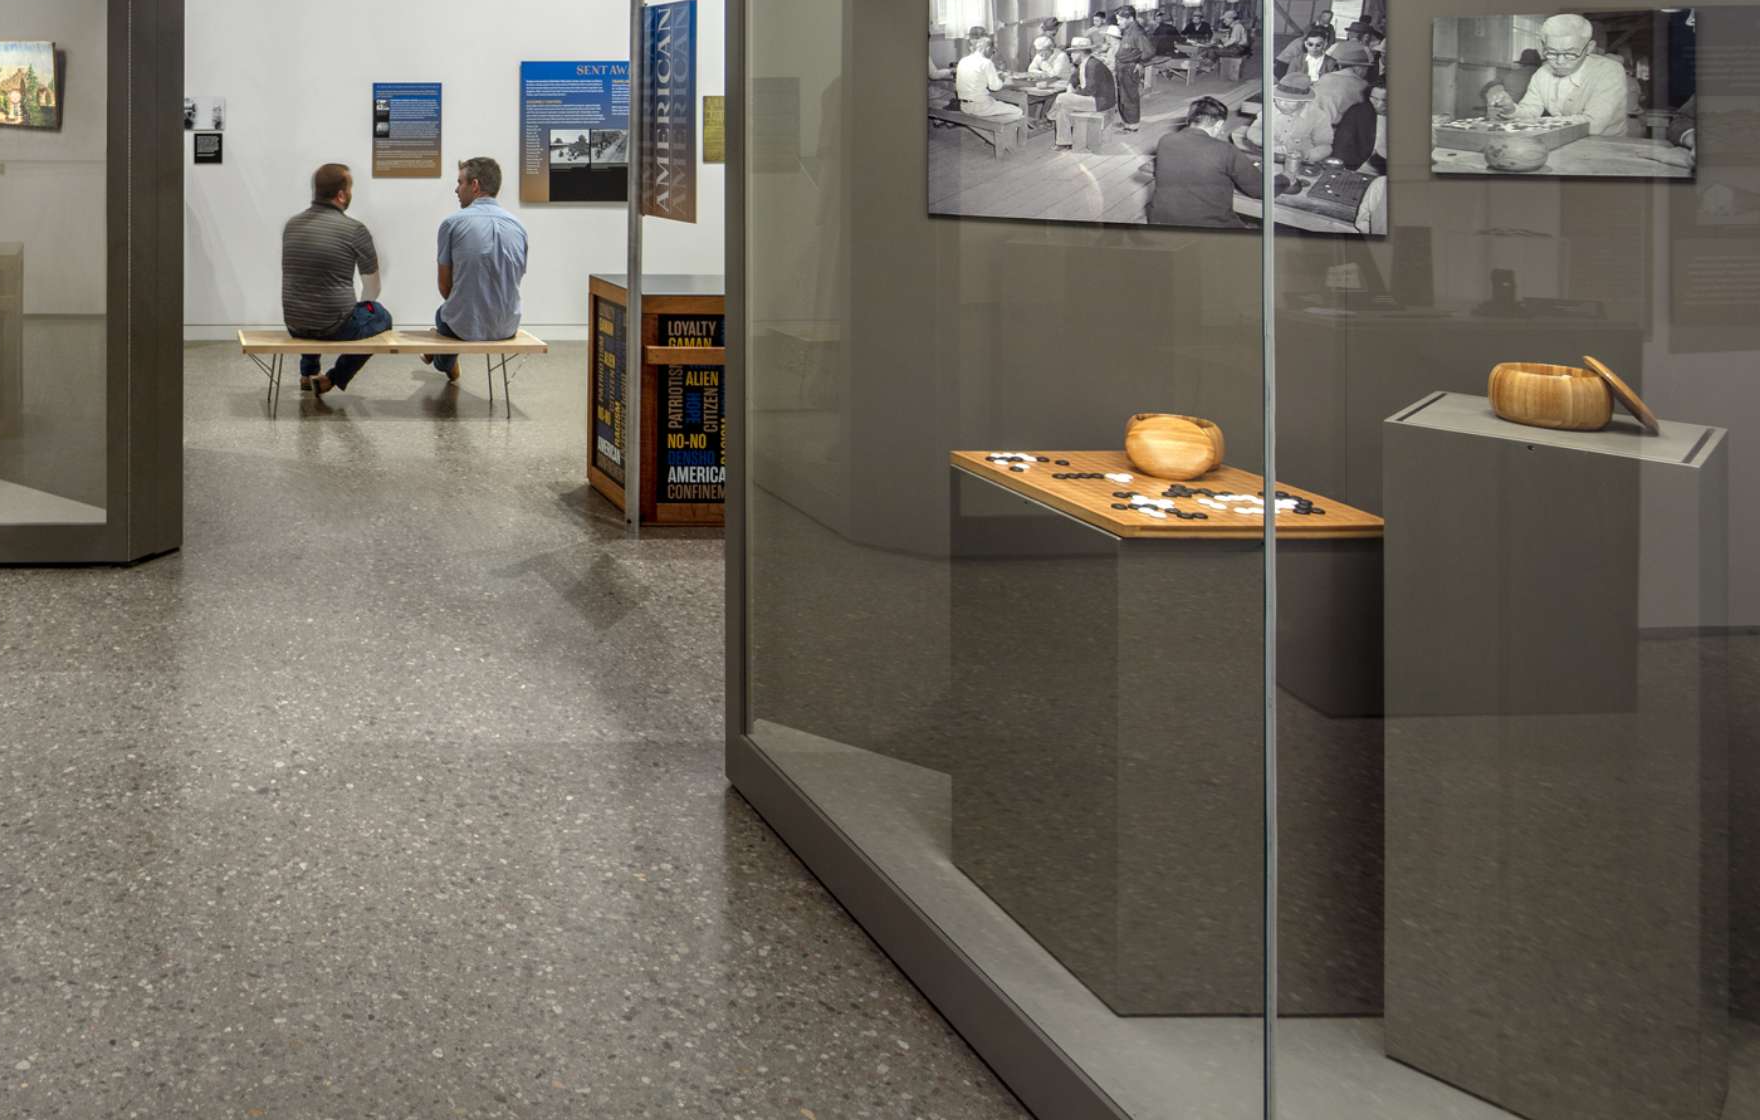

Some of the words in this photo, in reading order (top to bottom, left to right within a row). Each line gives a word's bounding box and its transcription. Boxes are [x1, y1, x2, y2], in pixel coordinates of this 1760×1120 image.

[576, 64, 609, 75] SENT
[610, 64, 629, 75] AW
[656, 8, 672, 213] AMERICAN
[668, 320, 717, 337] LOYALTY
[685, 371, 719, 386] ALIEN
[703, 388, 719, 433] CITIZEN
[667, 433, 707, 449] NO-NO
[667, 466, 726, 483] AMERICA
[667, 484, 726, 499] CONFINEM
